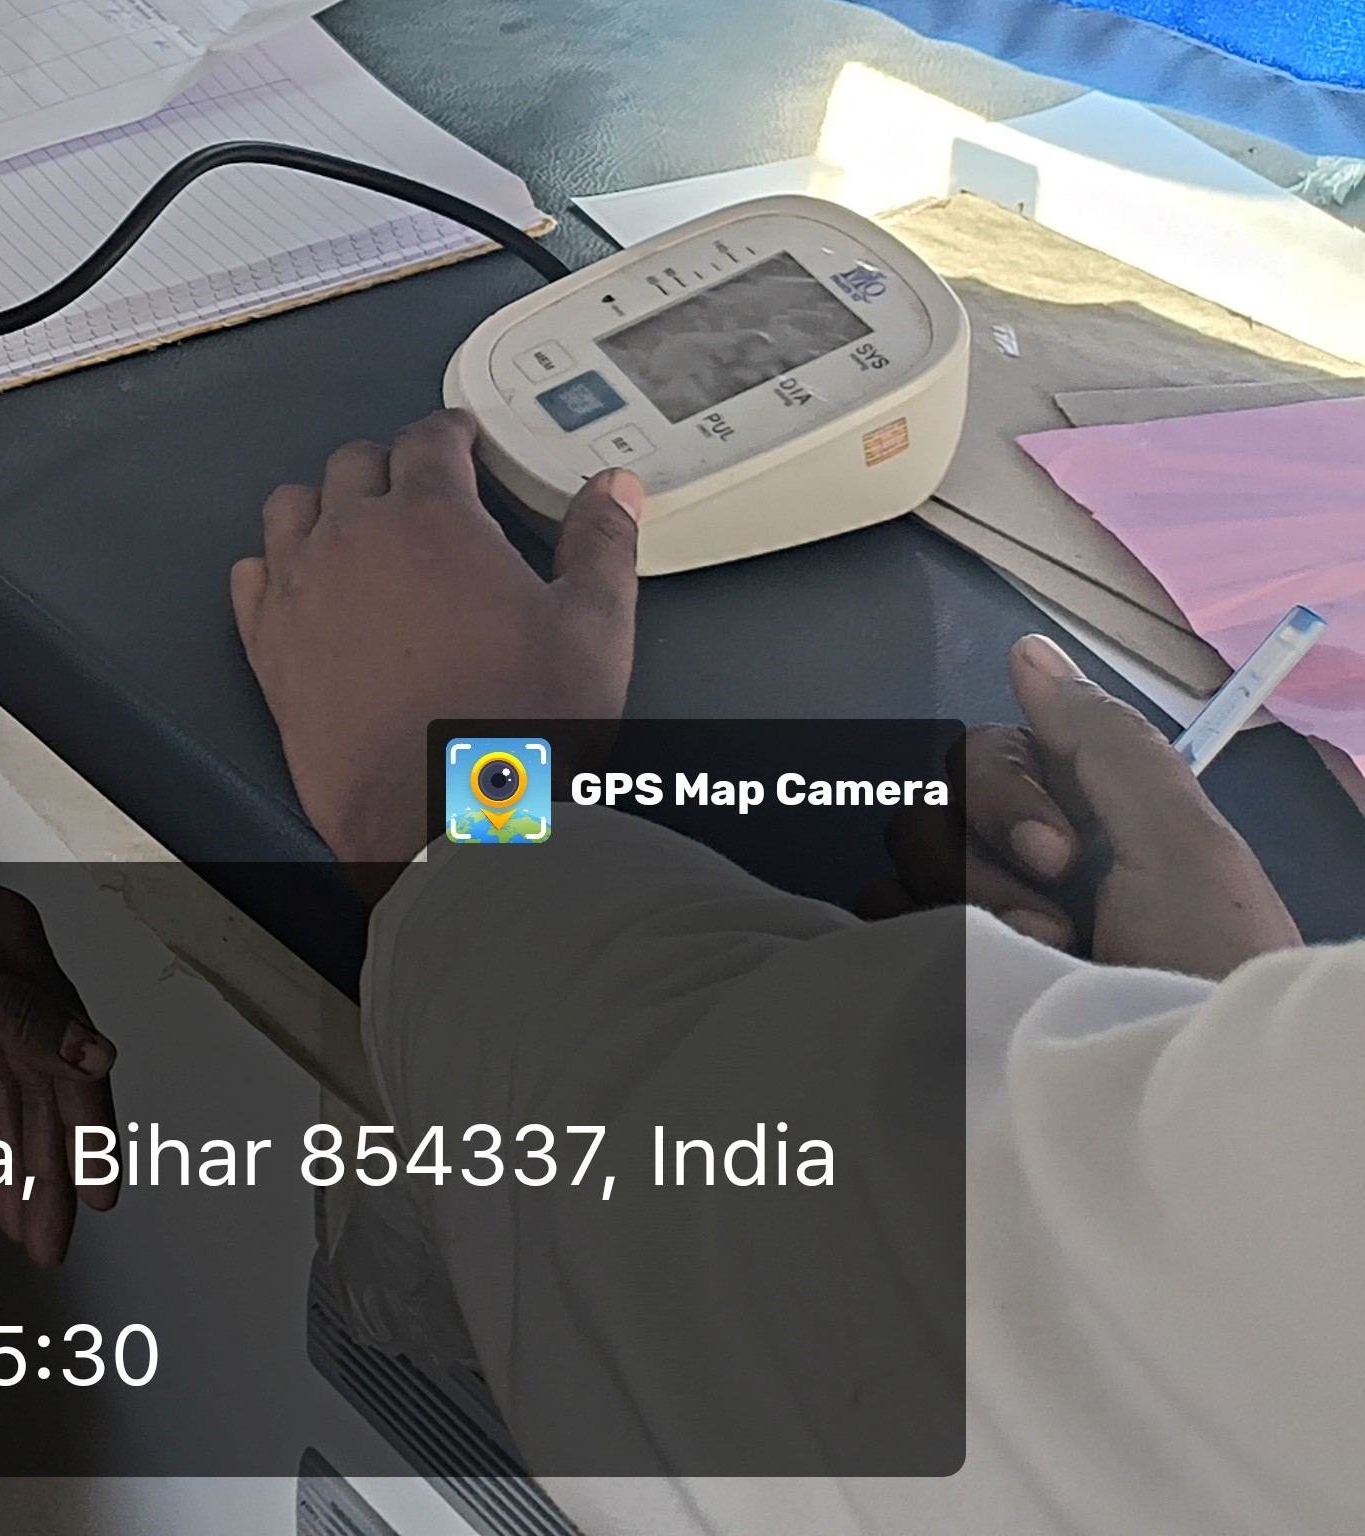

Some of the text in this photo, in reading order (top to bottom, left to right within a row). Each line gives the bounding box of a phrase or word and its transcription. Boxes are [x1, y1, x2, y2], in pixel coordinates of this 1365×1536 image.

[533, 350, 556, 371] MEM
[855, 342, 890, 370] SYS
[779, 377, 813, 406] DIA
[703, 412, 736, 442] PUL
[611, 436, 634, 454] SET
